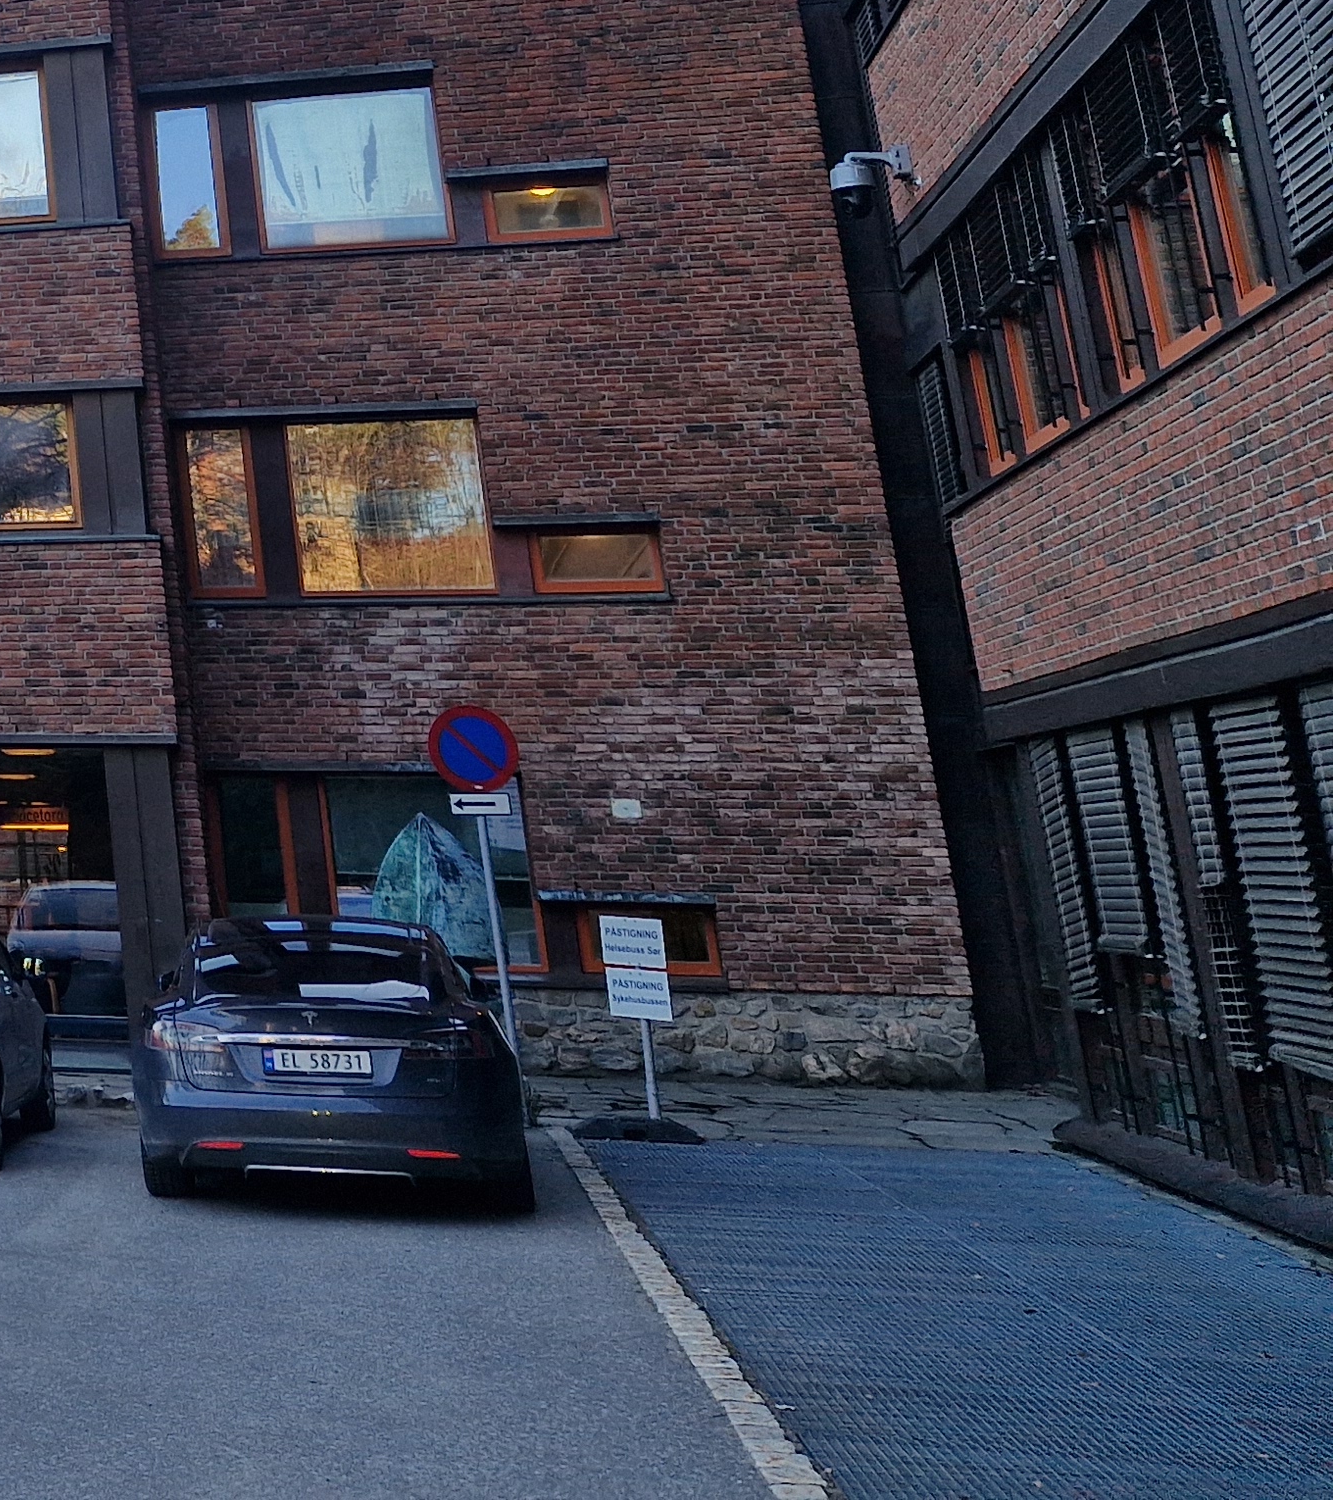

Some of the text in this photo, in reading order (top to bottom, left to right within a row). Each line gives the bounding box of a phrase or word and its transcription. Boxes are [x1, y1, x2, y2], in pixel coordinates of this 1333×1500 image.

[604, 926, 659, 940] PÅSTIGNING
[611, 977, 665, 992] PÅSTIGNING
[281, 1053, 300, 1069] EL
[310, 1053, 363, 1071] 58731
